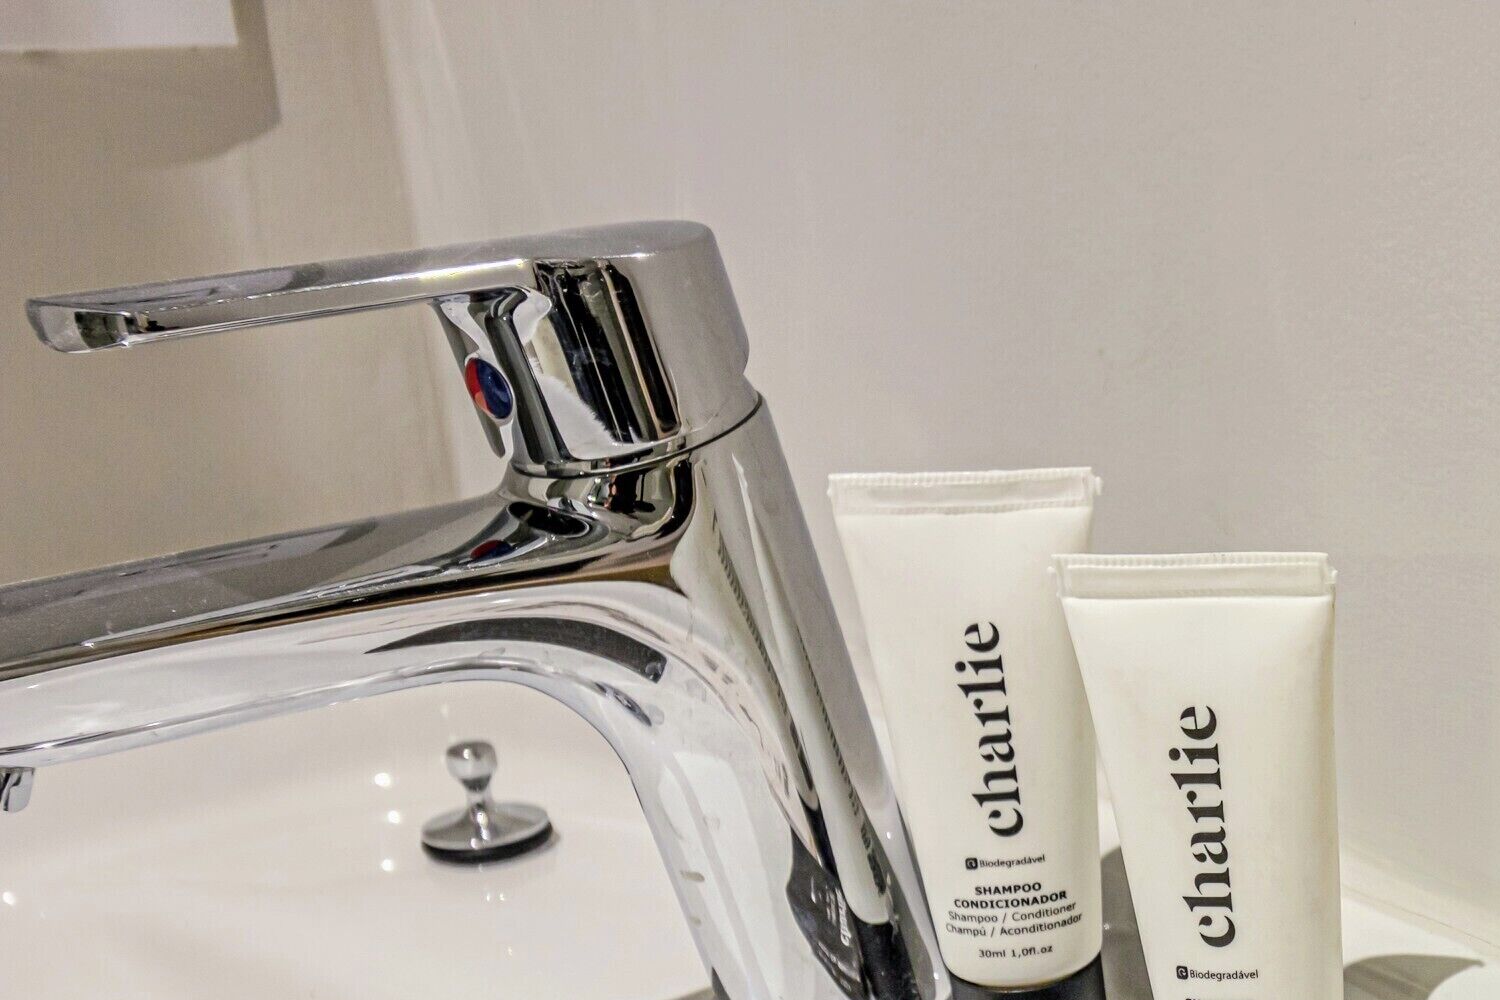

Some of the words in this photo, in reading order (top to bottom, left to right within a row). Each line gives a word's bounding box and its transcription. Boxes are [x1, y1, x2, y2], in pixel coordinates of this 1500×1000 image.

[954, 621, 1024, 837] charlie
[1168, 705, 1236, 948] charlie
[979, 854, 1046, 869] Biodegradável
[975, 882, 1042, 896] SHAMPOO
[954, 890, 1068, 909] CONDICIONADOR
[949, 911, 998, 924] Shampoo
[1011, 902, 1077, 922] Conditioner
[1000, 913, 1083, 936] Aconditionador
[978, 948, 1006, 958] 30ml
[1189, 969, 1259, 982] Biodegradável
